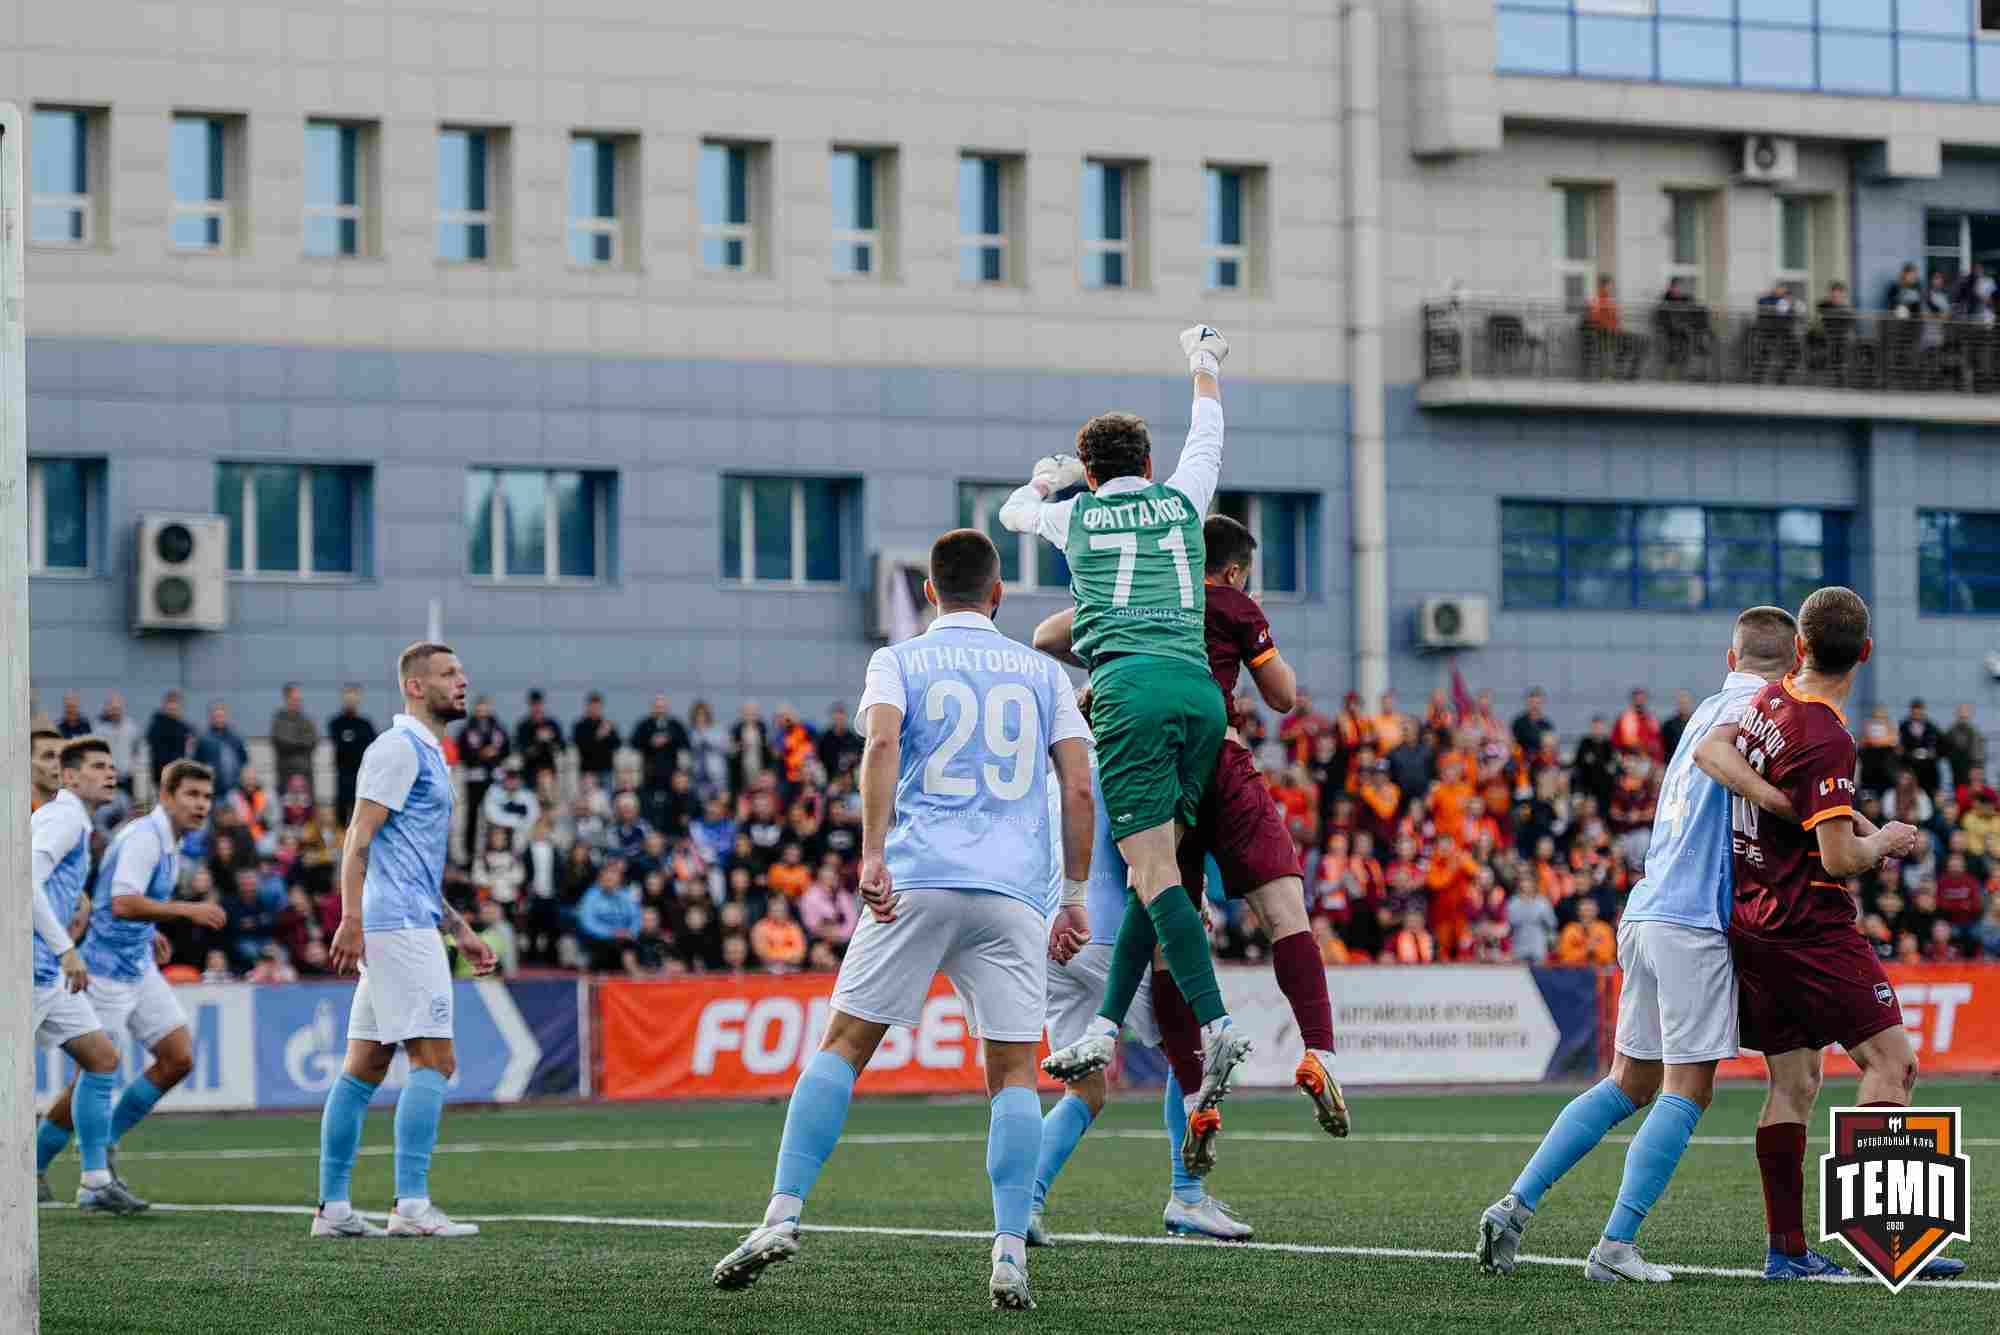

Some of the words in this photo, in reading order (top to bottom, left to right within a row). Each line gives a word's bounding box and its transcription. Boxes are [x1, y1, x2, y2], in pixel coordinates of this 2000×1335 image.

[1083, 496, 1188, 529] ФАТТАХОВ
[1089, 525, 1194, 608] 71
[923, 679, 1038, 801] 29
